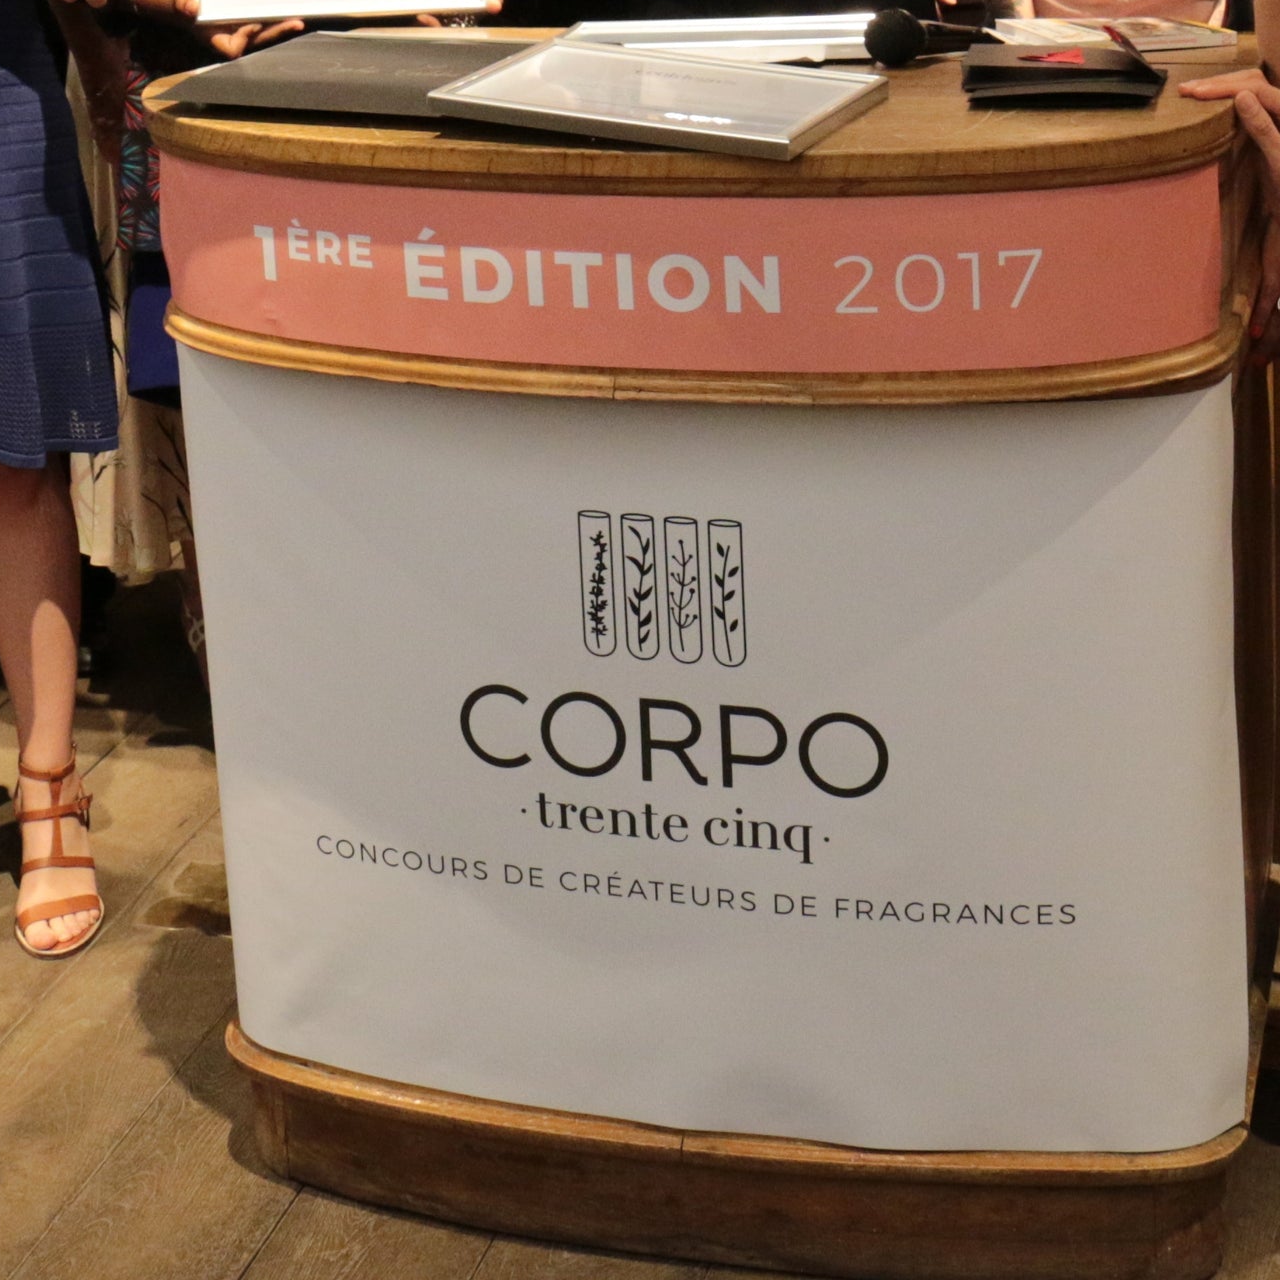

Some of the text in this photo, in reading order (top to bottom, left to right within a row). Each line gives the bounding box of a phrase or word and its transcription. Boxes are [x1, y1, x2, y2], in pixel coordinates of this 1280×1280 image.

[404, 228, 781, 313] ÉDITION
[834, 248, 1043, 314] 2017
[460, 684, 889, 798] CORPO
[317, 835, 1077, 925] CONCOURS DE CRÉATEURS DE FRAGRANCES
